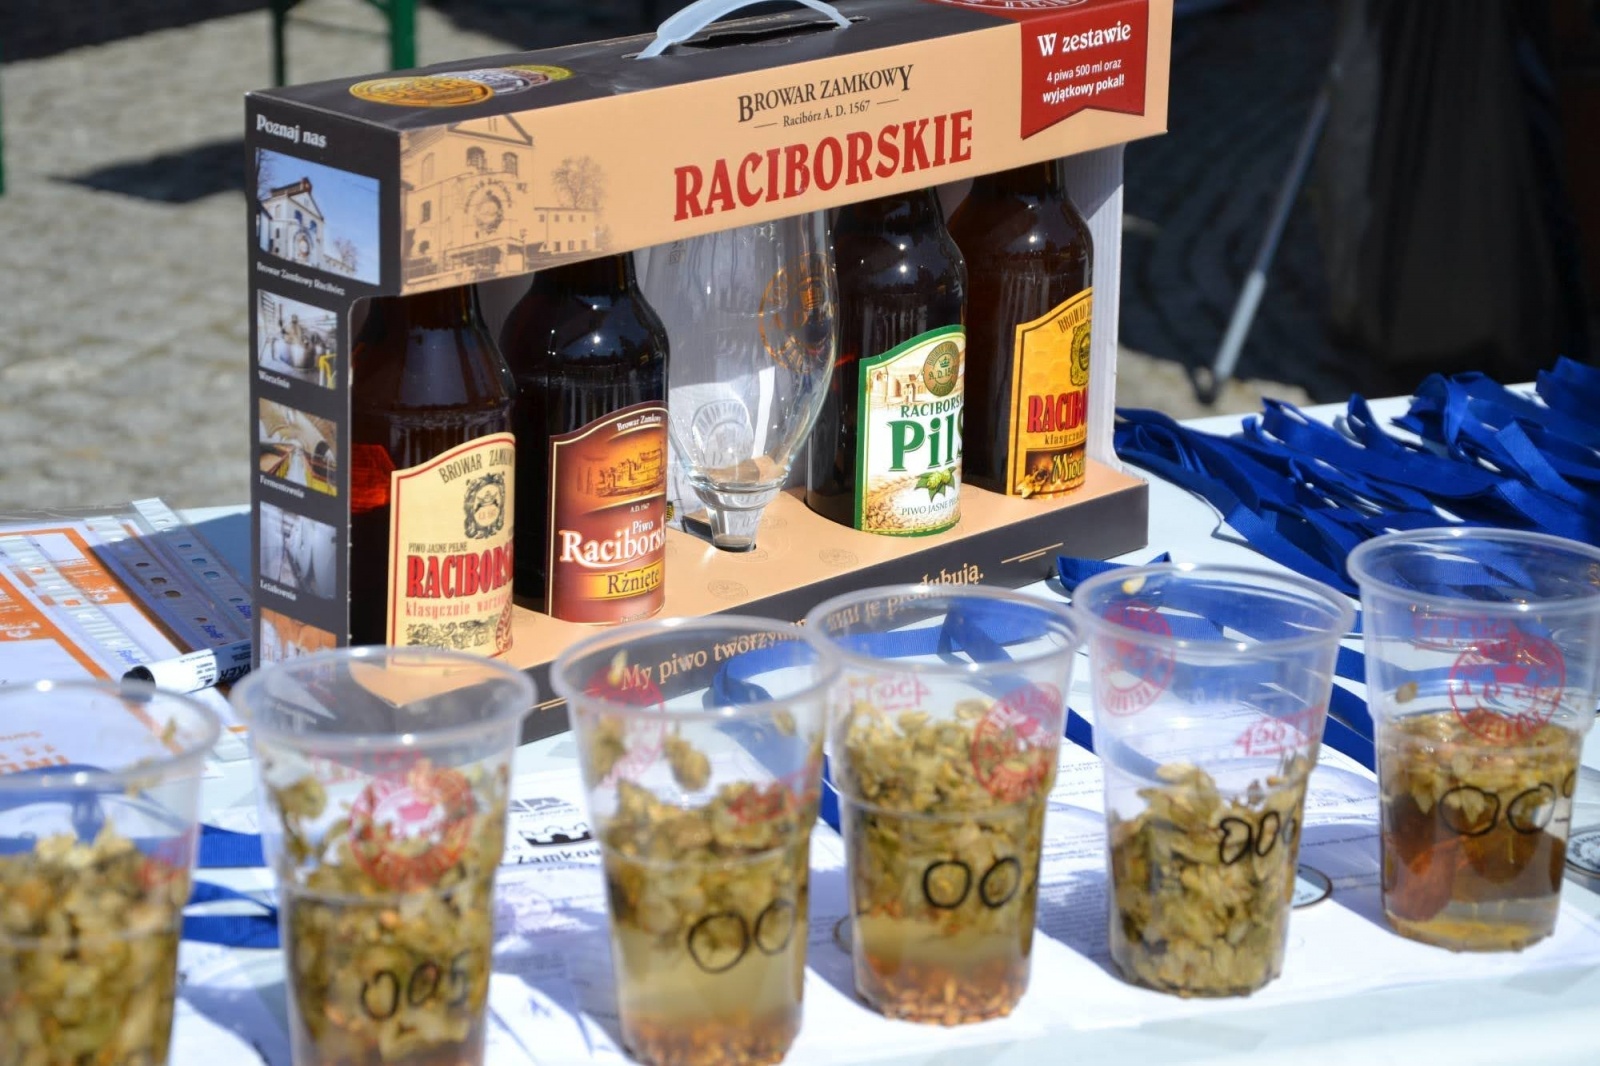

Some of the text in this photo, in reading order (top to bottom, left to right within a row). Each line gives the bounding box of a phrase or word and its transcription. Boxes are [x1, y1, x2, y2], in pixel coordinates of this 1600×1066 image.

[1037, 20, 1131, 57] W zestawie
[1047, 59, 1122, 85] 4 piwa 500 ml oraz
[737, 64, 914, 123] BROWAR ZAMKOWY
[1043, 73, 1125, 104] wyjątkowy pokal!
[783, 99, 871, 128] Racibórz A. D. 1567
[256, 113, 327, 149] Poznaj nas
[673, 108, 973, 222] RACIBORSKIE
[438, 453, 483, 485] BROWAR
[902, 503, 926, 516] PIWO
[927, 500, 949, 516] JASNE
[632, 519, 654, 538] Piwo
[408, 542, 426, 553] PIWO
[427, 542, 447, 553] JASNE
[621, 665, 652, 690] My
[659, 652, 707, 684] piwo
